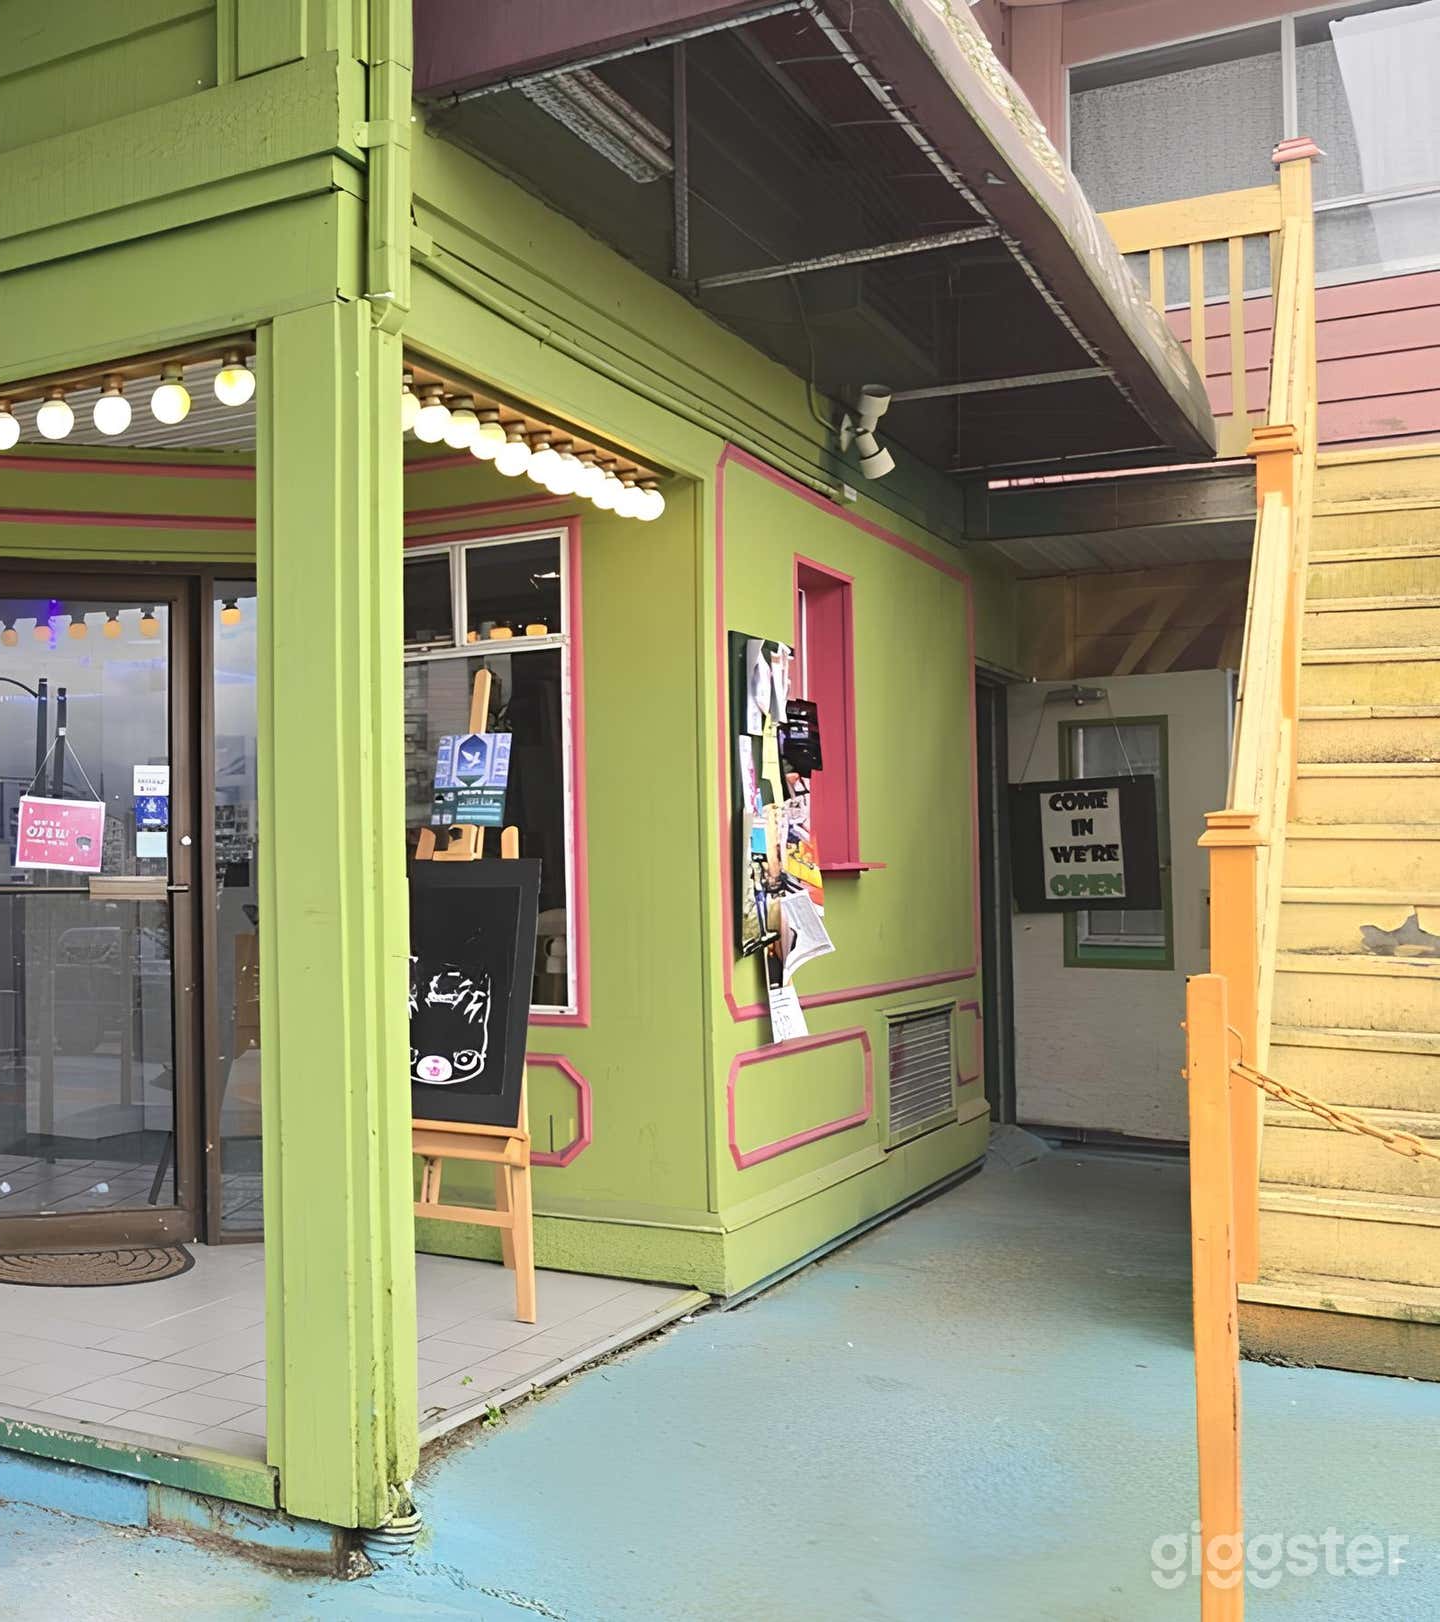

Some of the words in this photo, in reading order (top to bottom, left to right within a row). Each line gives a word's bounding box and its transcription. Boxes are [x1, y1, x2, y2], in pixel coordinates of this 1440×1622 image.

[1049, 791, 1108, 811] COME
[1071, 818, 1093, 836] IN
[1050, 873, 1123, 896] OPEN
